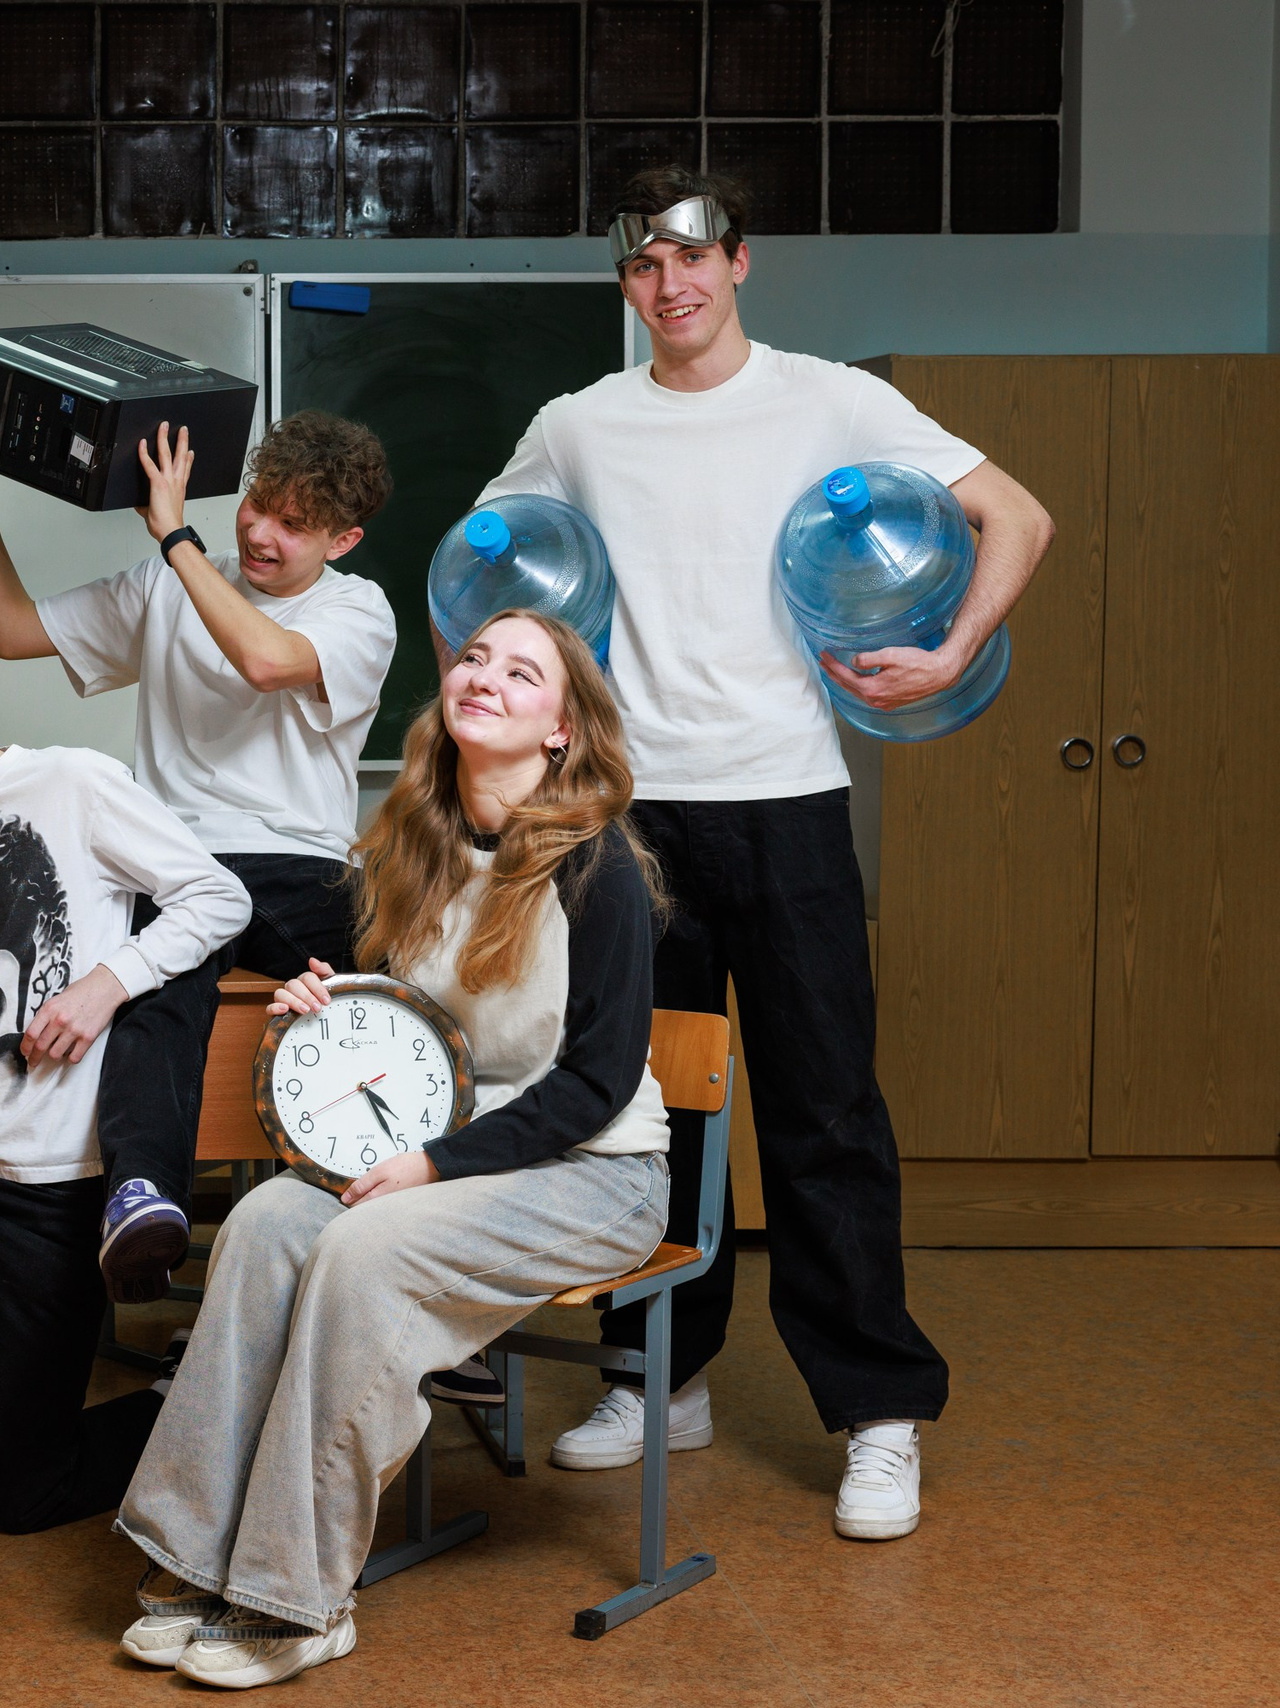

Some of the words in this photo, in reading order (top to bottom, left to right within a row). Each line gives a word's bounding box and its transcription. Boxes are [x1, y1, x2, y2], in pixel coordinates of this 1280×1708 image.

[319, 1018, 329, 1040] 11
[349, 1007, 367, 1030] 12
[389, 1015, 395, 1037] 1
[292, 1044, 320, 1067] 10
[412, 1039, 426, 1061] 2
[286, 1078, 303, 1101] 9
[426, 1073, 438, 1096] 3
[298, 1111, 314, 1134] 8
[420, 1107, 431, 1128] 4
[327, 1137, 337, 1159] 7
[396, 1133, 408, 1152] 5
[360, 1143, 377, 1165] 6
